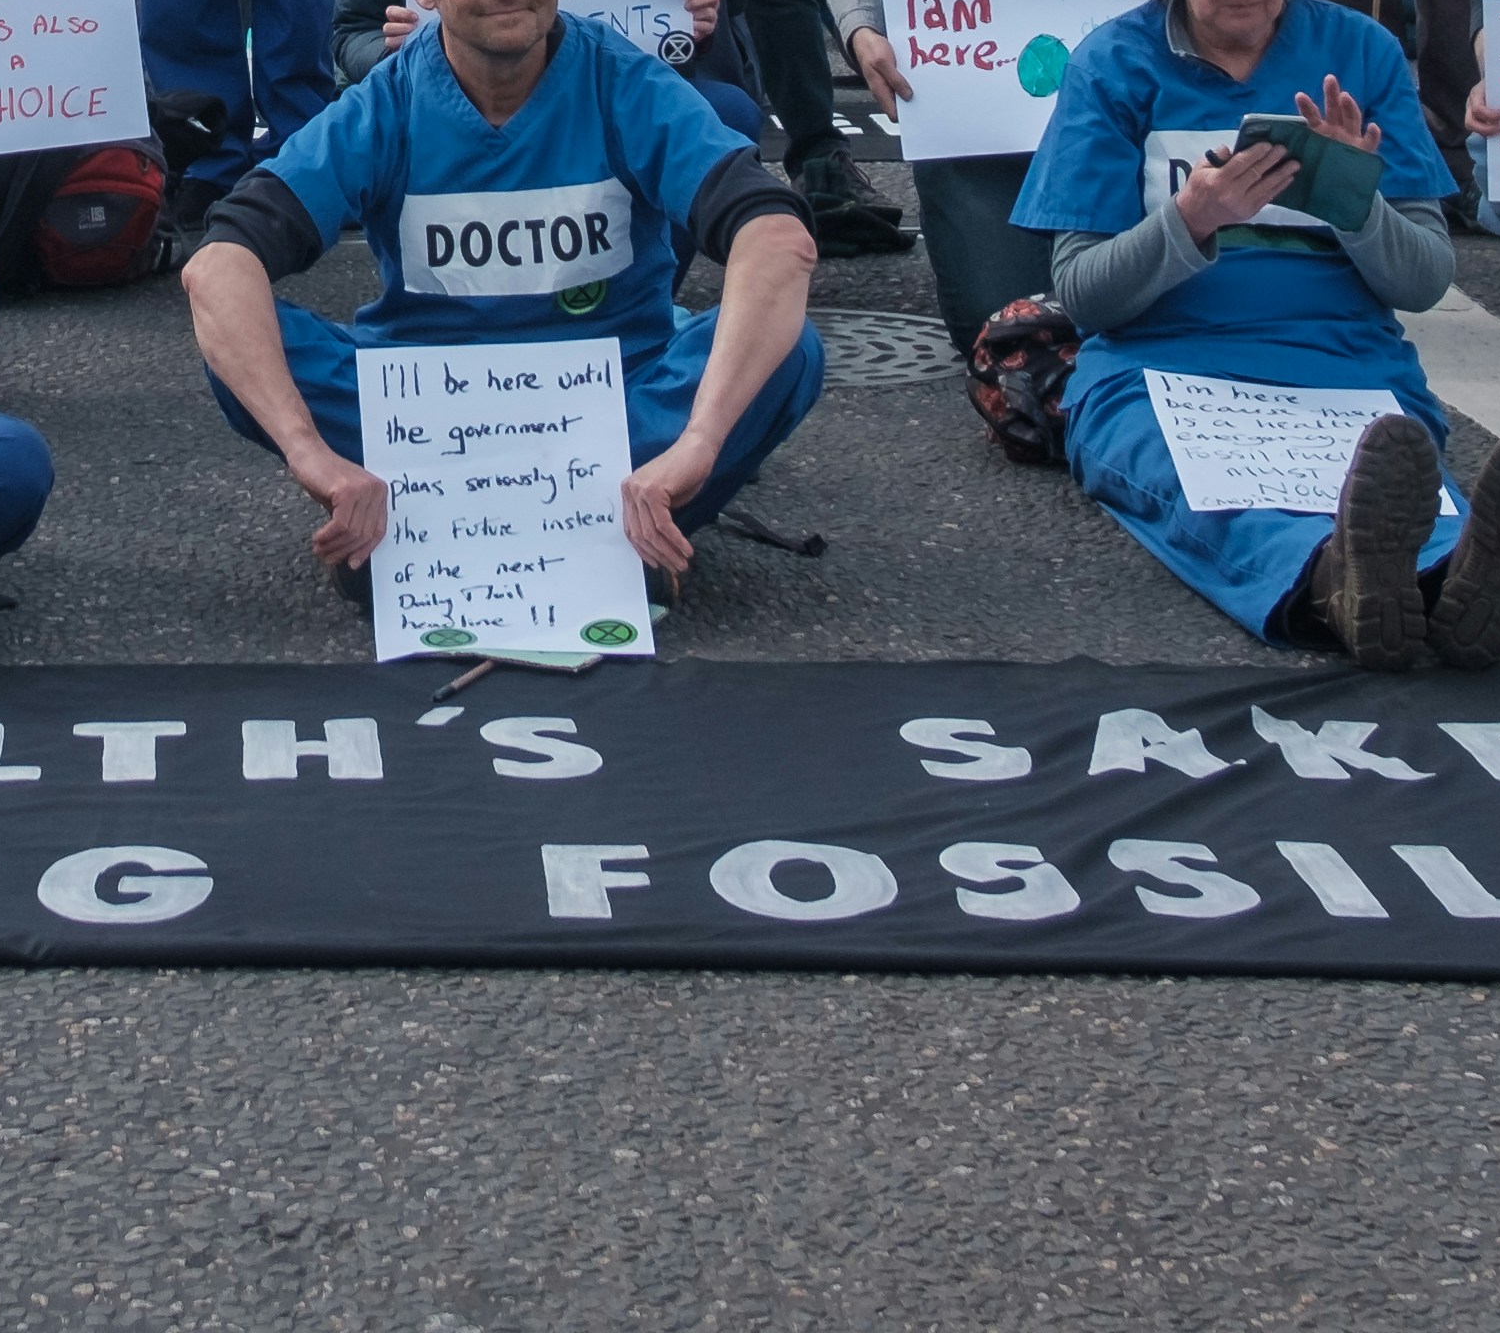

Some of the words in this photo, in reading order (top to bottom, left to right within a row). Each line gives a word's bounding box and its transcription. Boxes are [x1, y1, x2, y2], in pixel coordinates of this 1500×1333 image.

[34, 15, 99, 35] ALSO
[426, 212, 612, 267] DOCTOR
[444, 362, 470, 395] be
[488, 369, 544, 392] here
[558, 359, 612, 389] until
[387, 415, 431, 444] the
[441, 415, 583, 455] government
[394, 517, 429, 544] the
[394, 563, 415, 583] of
[428, 560, 464, 578] the
[496, 555, 565, 575] next
